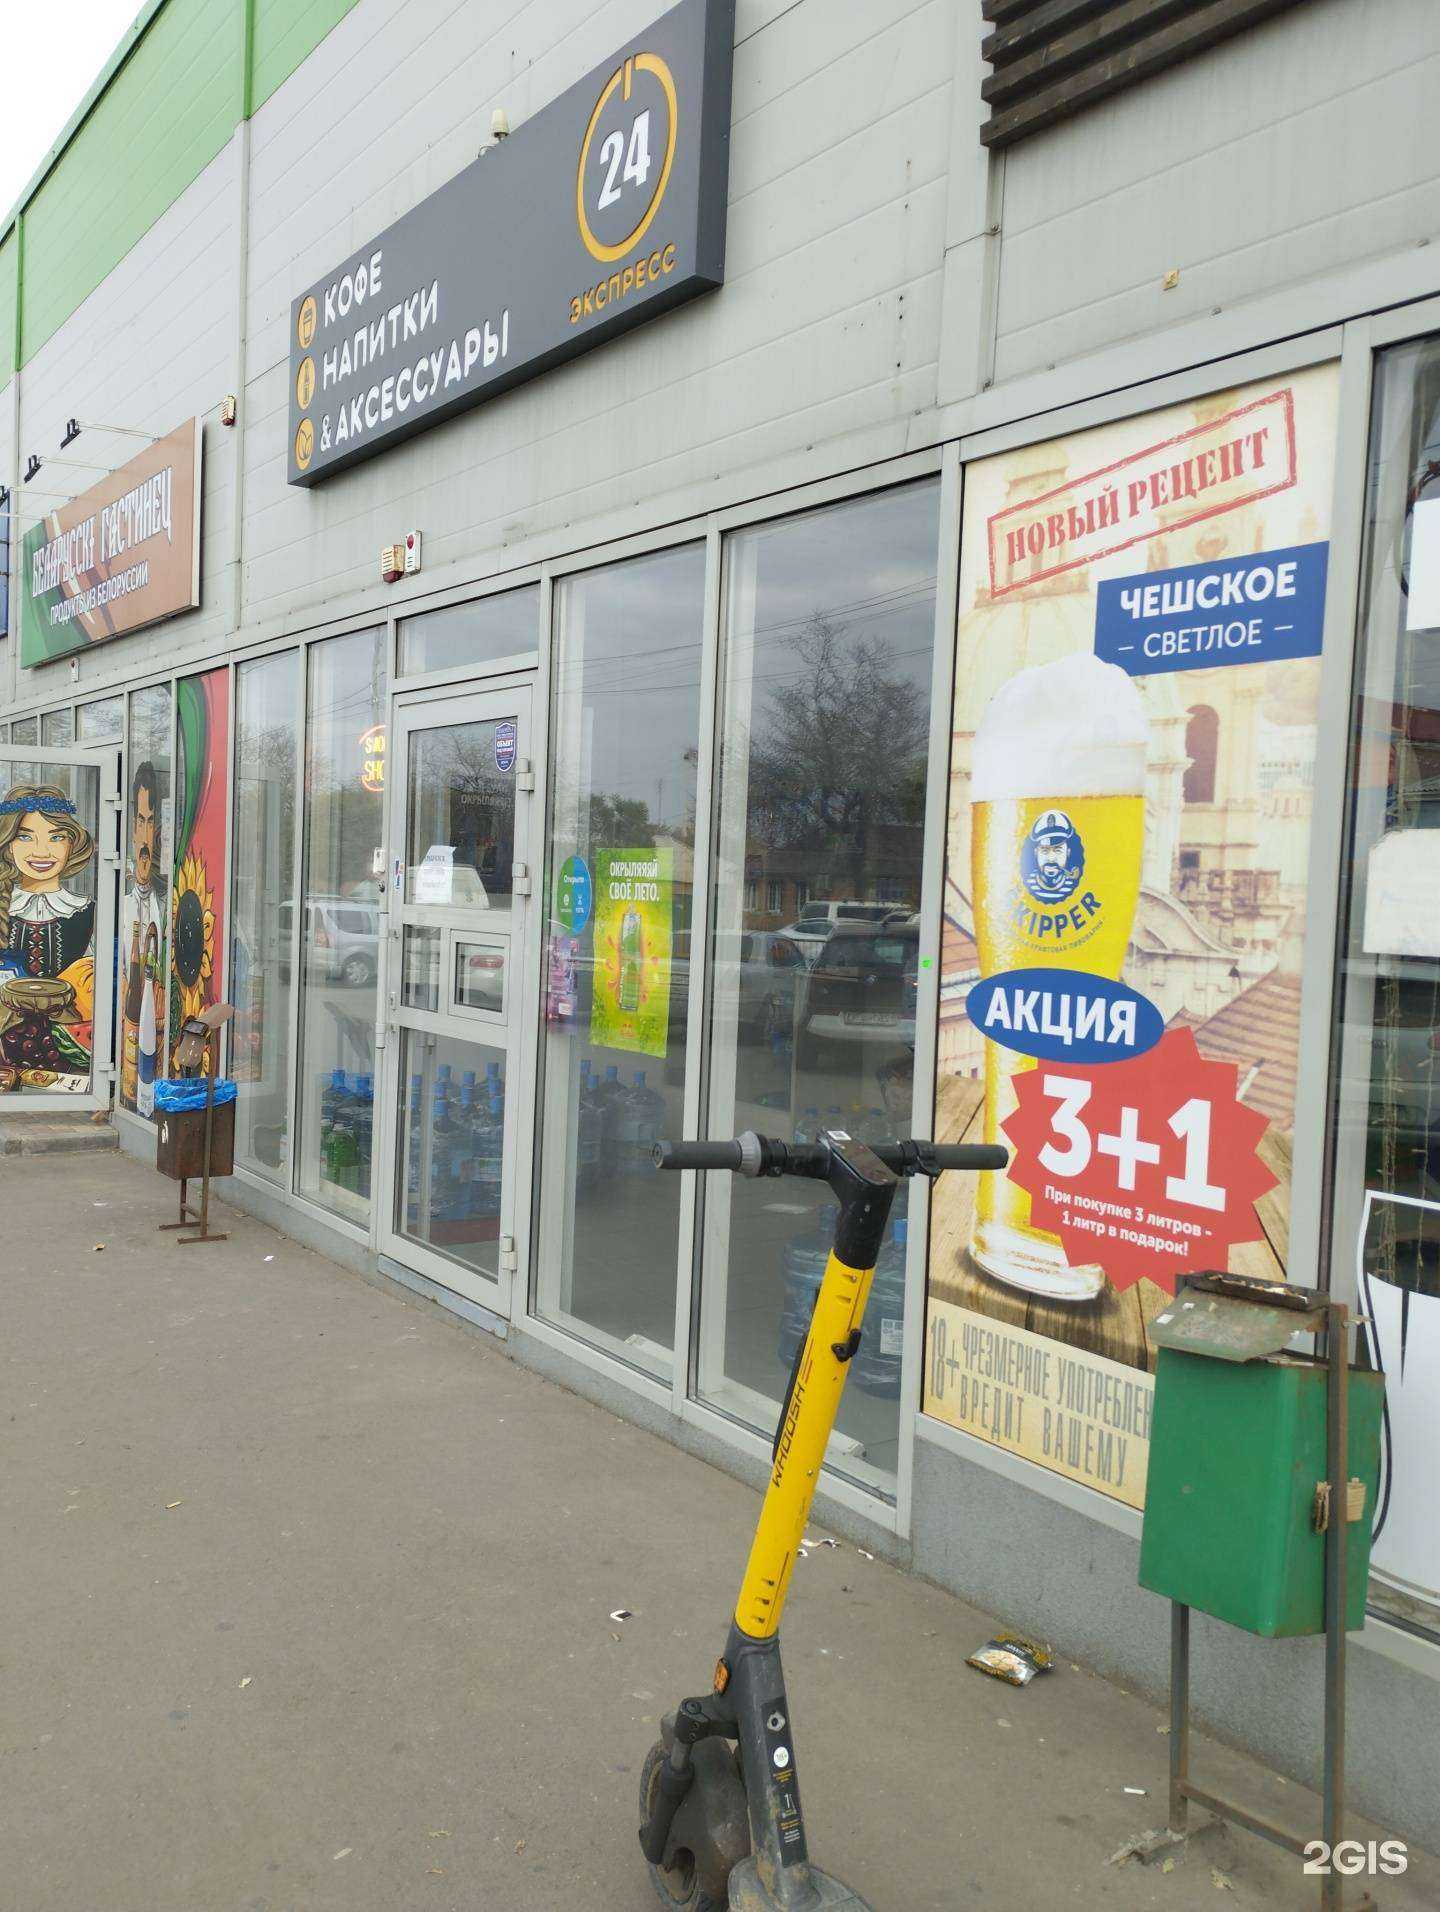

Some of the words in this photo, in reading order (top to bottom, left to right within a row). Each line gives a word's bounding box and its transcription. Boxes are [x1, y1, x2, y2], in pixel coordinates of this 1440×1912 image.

[597, 109, 650, 211] 24
[324, 249, 383, 328] КОФЕ
[569, 243, 677, 324] ЭКСПРЕСС
[323, 280, 438, 390] НАПИТКИ
[335, 309, 509, 445] АКСЕССУАРЫ
[1006, 485, 1120, 565] НОВЫЙ
[1127, 427, 1270, 516] РЕЦЕПТ
[50, 593, 87, 626] ПРОДУКТЫ
[97, 561, 148, 606] БЕЛОРУССИИ
[1120, 562, 1298, 619] ЧЕШСКОЕ
[1143, 618, 1263, 658] СВЕТЛОЕ
[609, 879, 631, 900] СВОЁ
[1008, 889, 1102, 938] KIPPER
[984, 987, 1137, 1046] АКЦИЯ
[1038, 1074, 1226, 1212] 3+1
[1045, 1185, 1071, 1205] При
[1074, 1194, 1132, 1219] покупке
[1134, 1206, 1144, 1222] 3
[1147, 1213, 1201, 1237] литров
[1062, 1211, 1070, 1225] 1
[1073, 1216, 1106, 1236] литр
[1108, 1226, 1117, 1237] в
[1119, 1228, 1189, 1256] подарок!
[930, 1315, 959, 1401] 18+
[963, 1322, 1051, 1400] ЧРЕЗМЕРНОЕ
[772, 1382, 805, 1488] WHOOSH
[960, 1374, 1024, 1443] ВРЕДИТ
[1042, 1406, 1128, 1488] ВАШЕМУ
